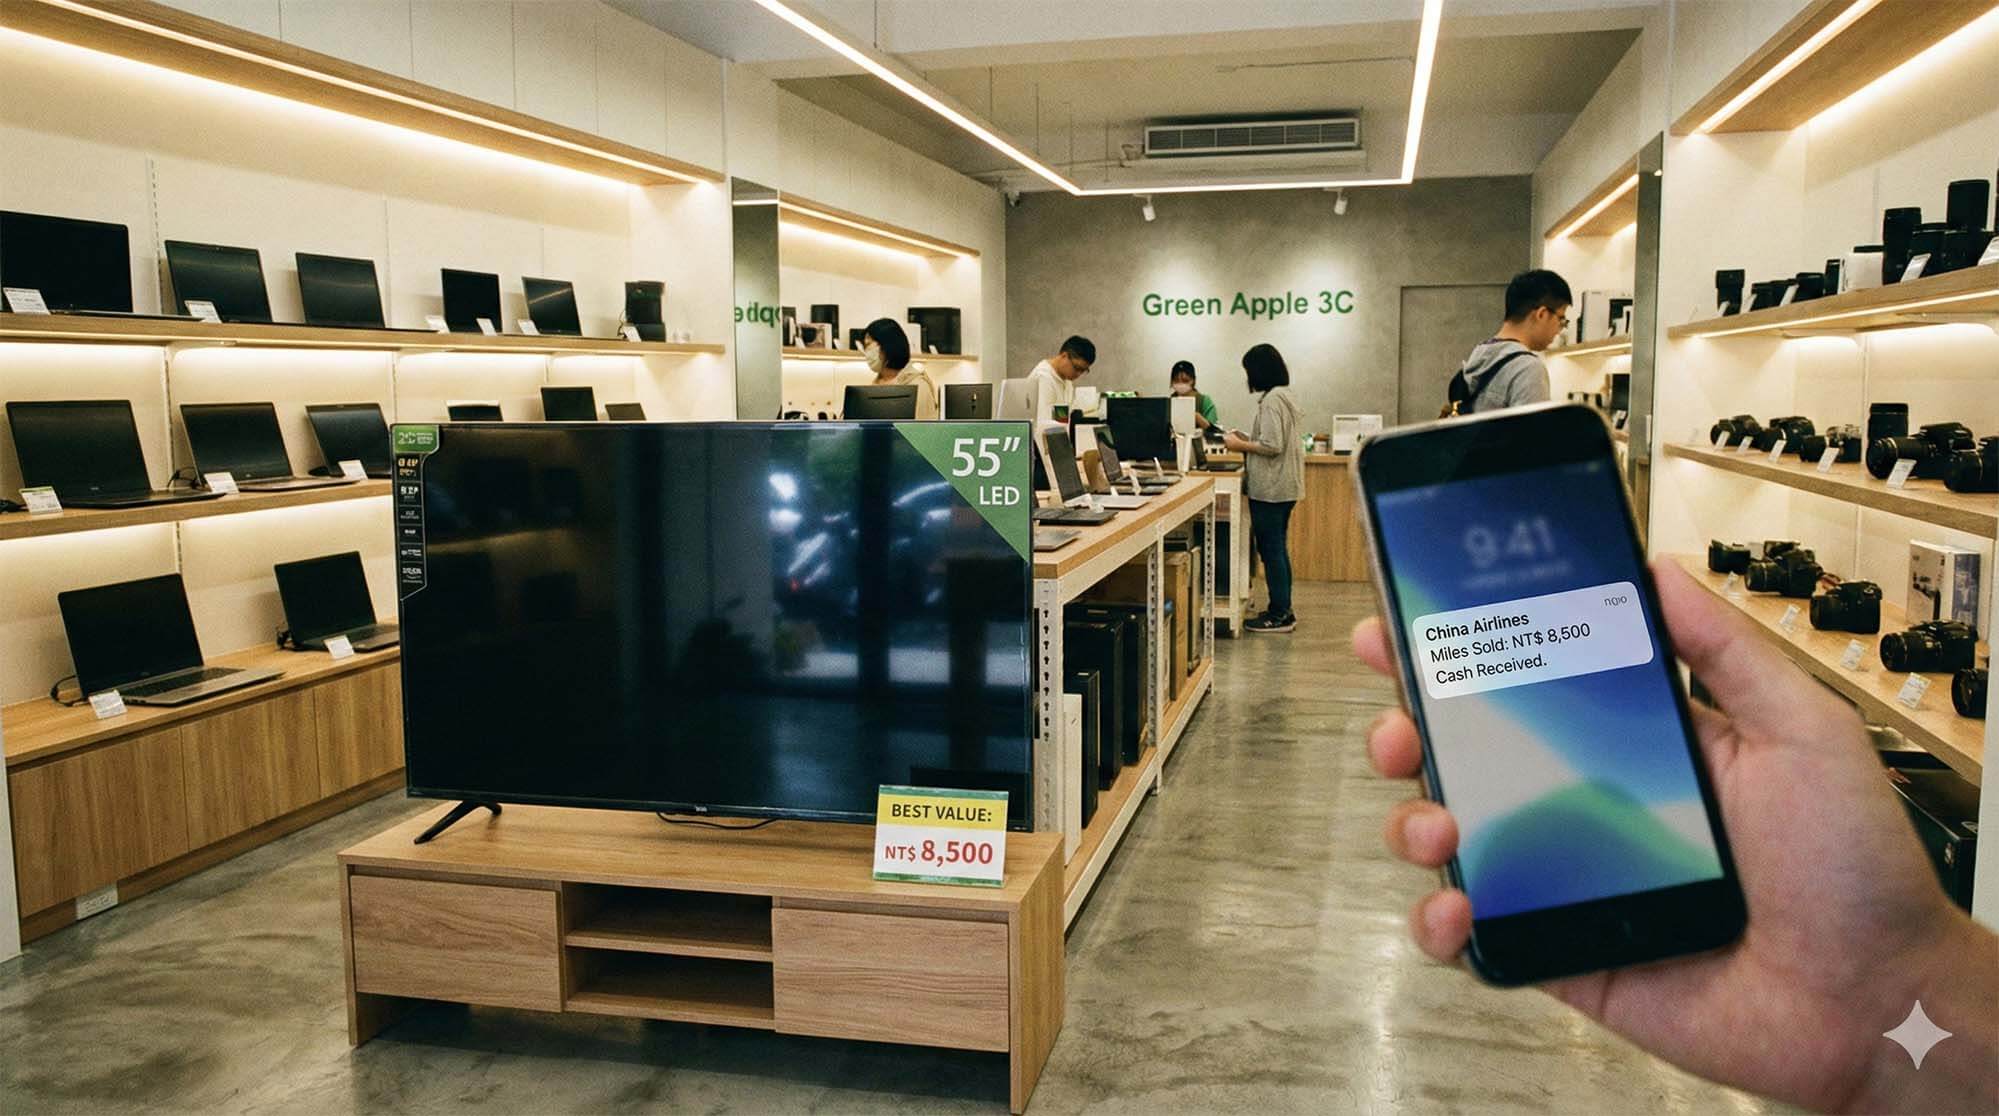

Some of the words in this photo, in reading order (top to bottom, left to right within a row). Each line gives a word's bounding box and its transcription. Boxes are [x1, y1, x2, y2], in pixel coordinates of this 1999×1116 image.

[1142, 293, 1222, 316] Green
[1229, 291, 1309, 320] Apple
[1318, 290, 1354, 314] 3C
[952, 436, 1021, 477] 55"
[979, 486, 1020, 505] LED
[1425, 623, 1470, 642] China
[1473, 612, 1530, 634] Airlines
[1430, 645, 1469, 663] Miles
[1472, 638, 1509, 656] Sold:
[1512, 631, 1544, 648] NT$
[1547, 623, 1591, 643] 8,500
[1436, 666, 1473, 684] Cash
[1477, 654, 1548, 677] Received.
[892, 803, 932, 819] BEST
[936, 805, 992, 822] VALUE:
[885, 845, 916, 862] NT$
[921, 840, 993, 867] 8,500
